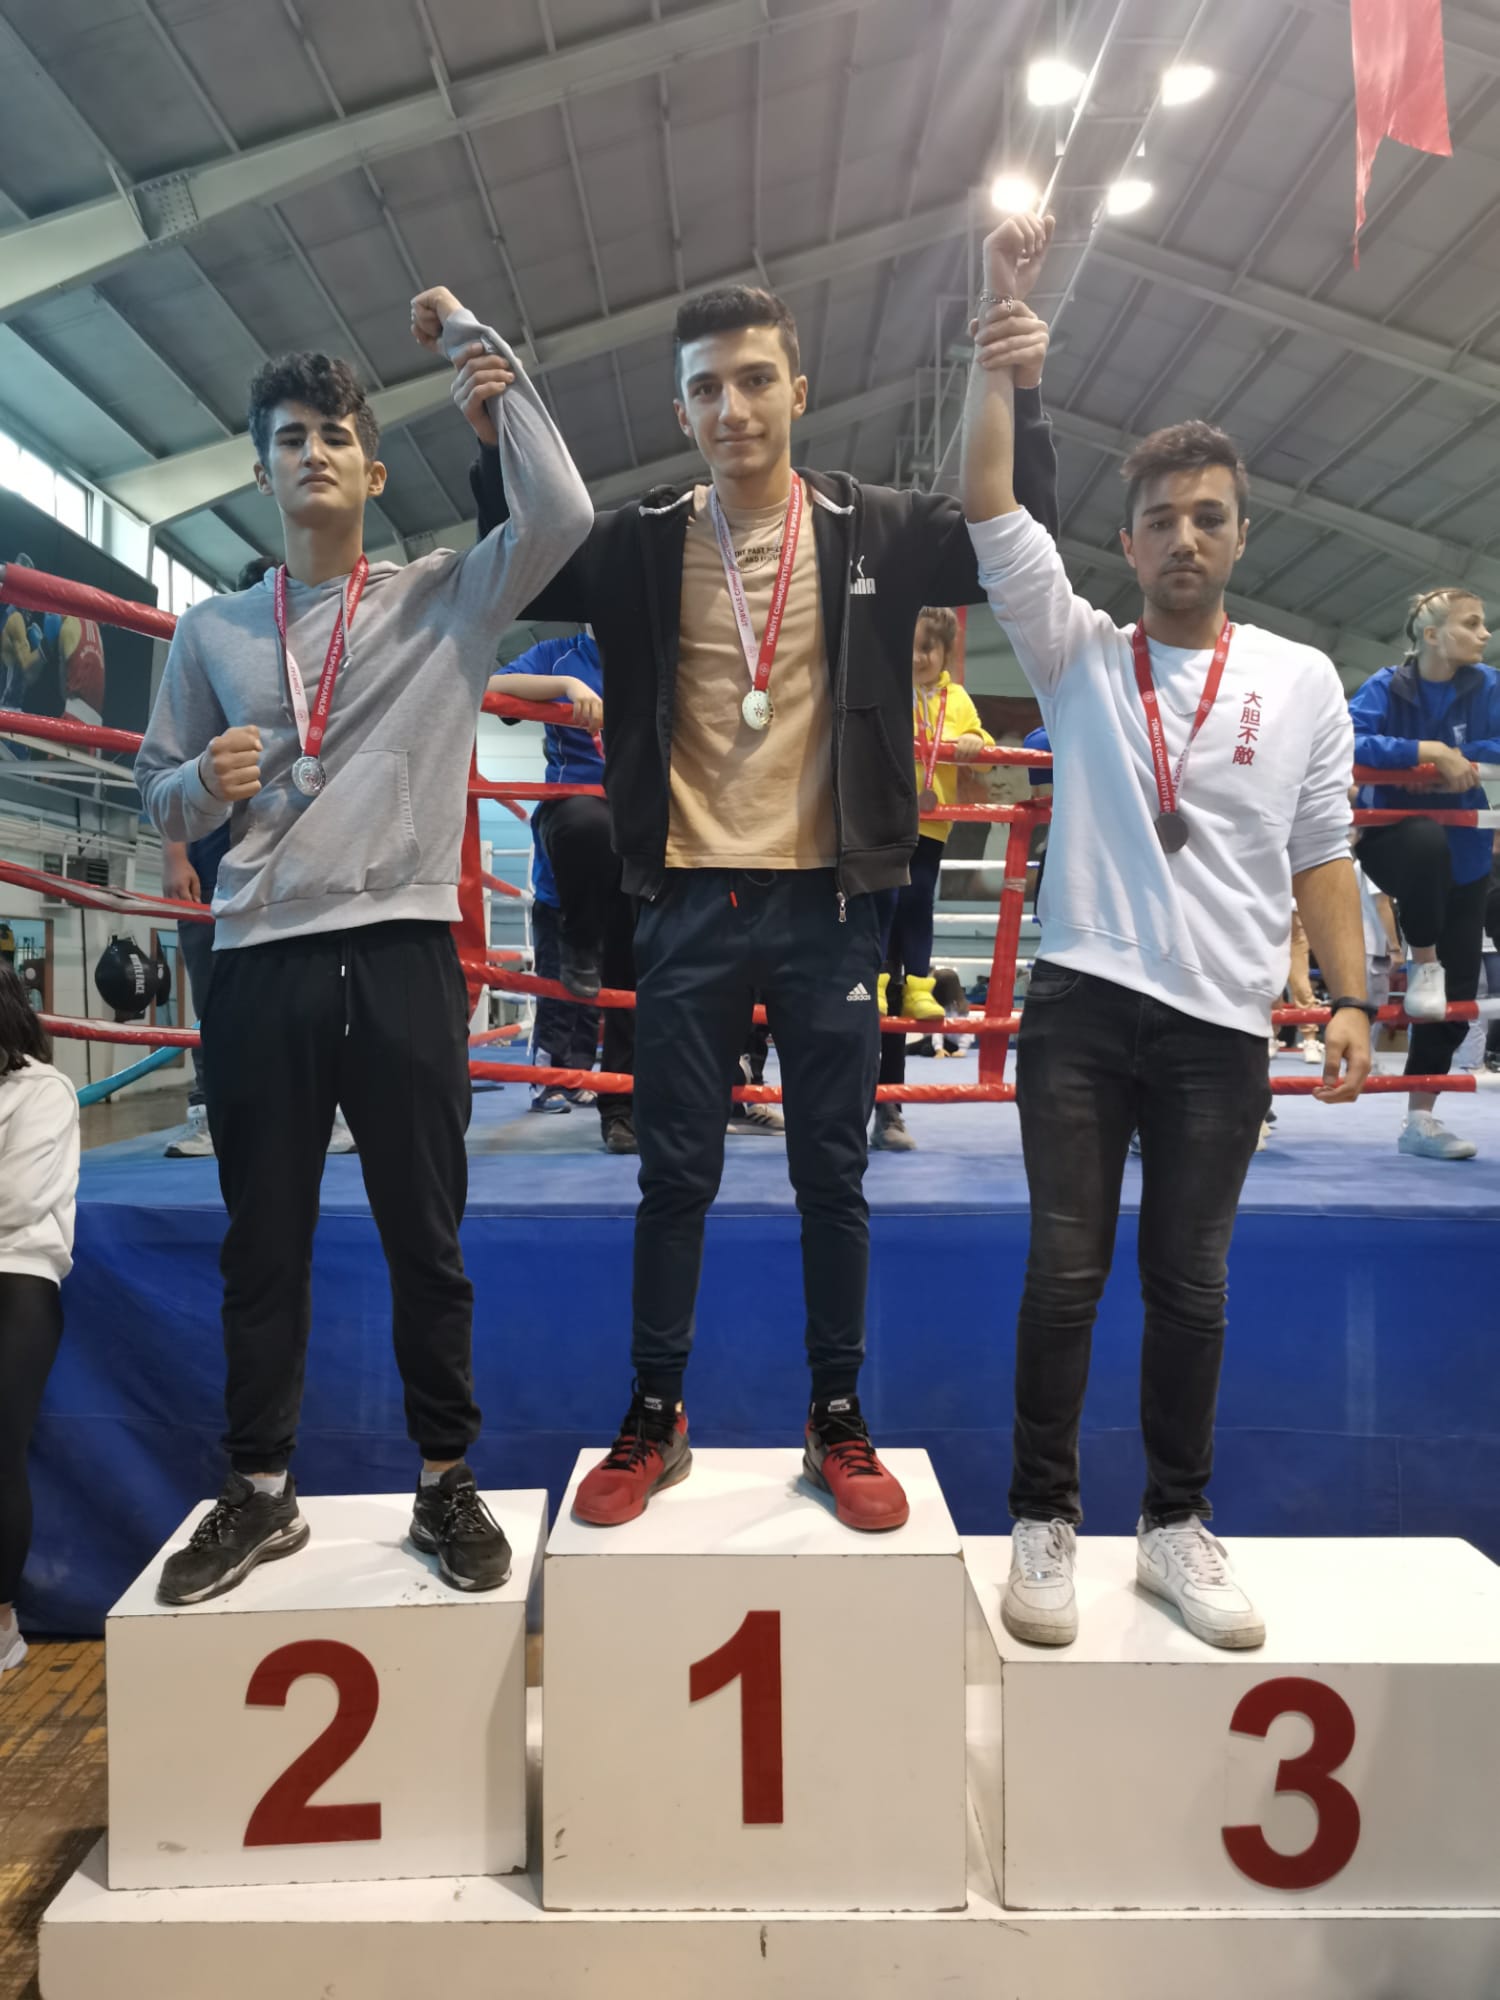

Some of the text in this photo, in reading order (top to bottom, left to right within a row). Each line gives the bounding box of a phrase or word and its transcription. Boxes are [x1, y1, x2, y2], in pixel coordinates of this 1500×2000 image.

[766, 615, 779, 646] TÜRKİYE
[774, 564, 790, 615] CUMHURİYETİ
[317, 675, 332, 716] BAKANLIĞI
[326, 655, 337, 675] SPOR
[1151, 717, 1162, 747] TÜRKİYE
[1232, 691, 1263, 766] 大胆不敵
[243, 1639, 382, 1846] 2
[689, 1611, 784, 1824] 1
[1222, 1678, 1361, 1889] 3
